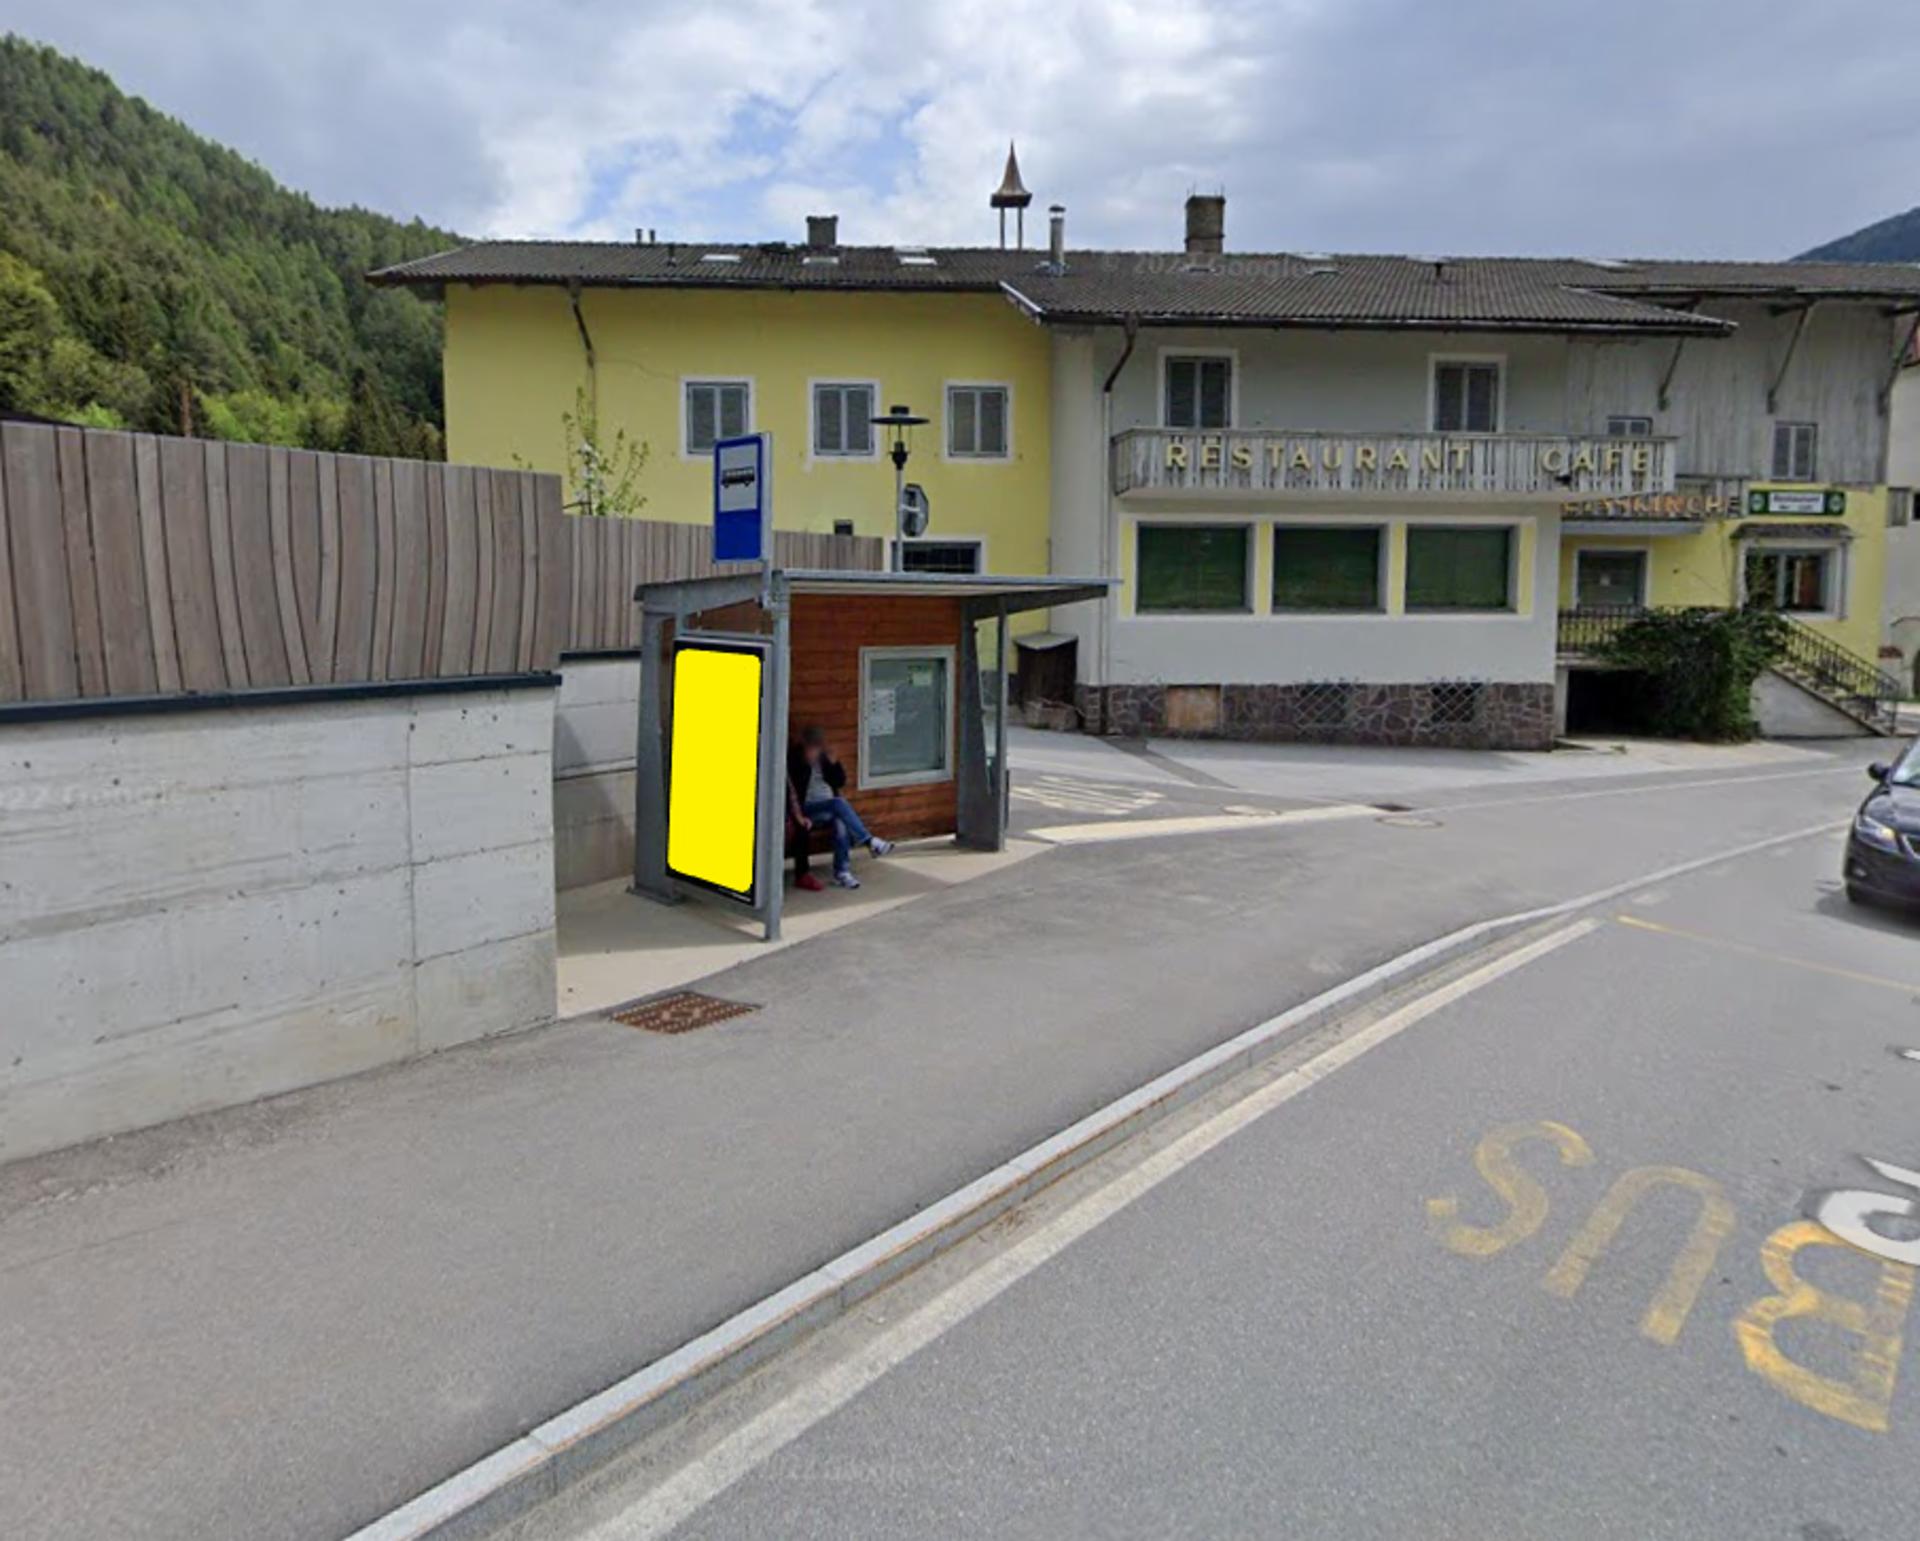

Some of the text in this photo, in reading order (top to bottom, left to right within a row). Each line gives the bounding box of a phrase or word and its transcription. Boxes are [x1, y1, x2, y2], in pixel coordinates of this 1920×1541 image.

[1165, 442, 1650, 473] RESTAURANT CAFE
[1425, 1120, 1916, 1432] BUS
